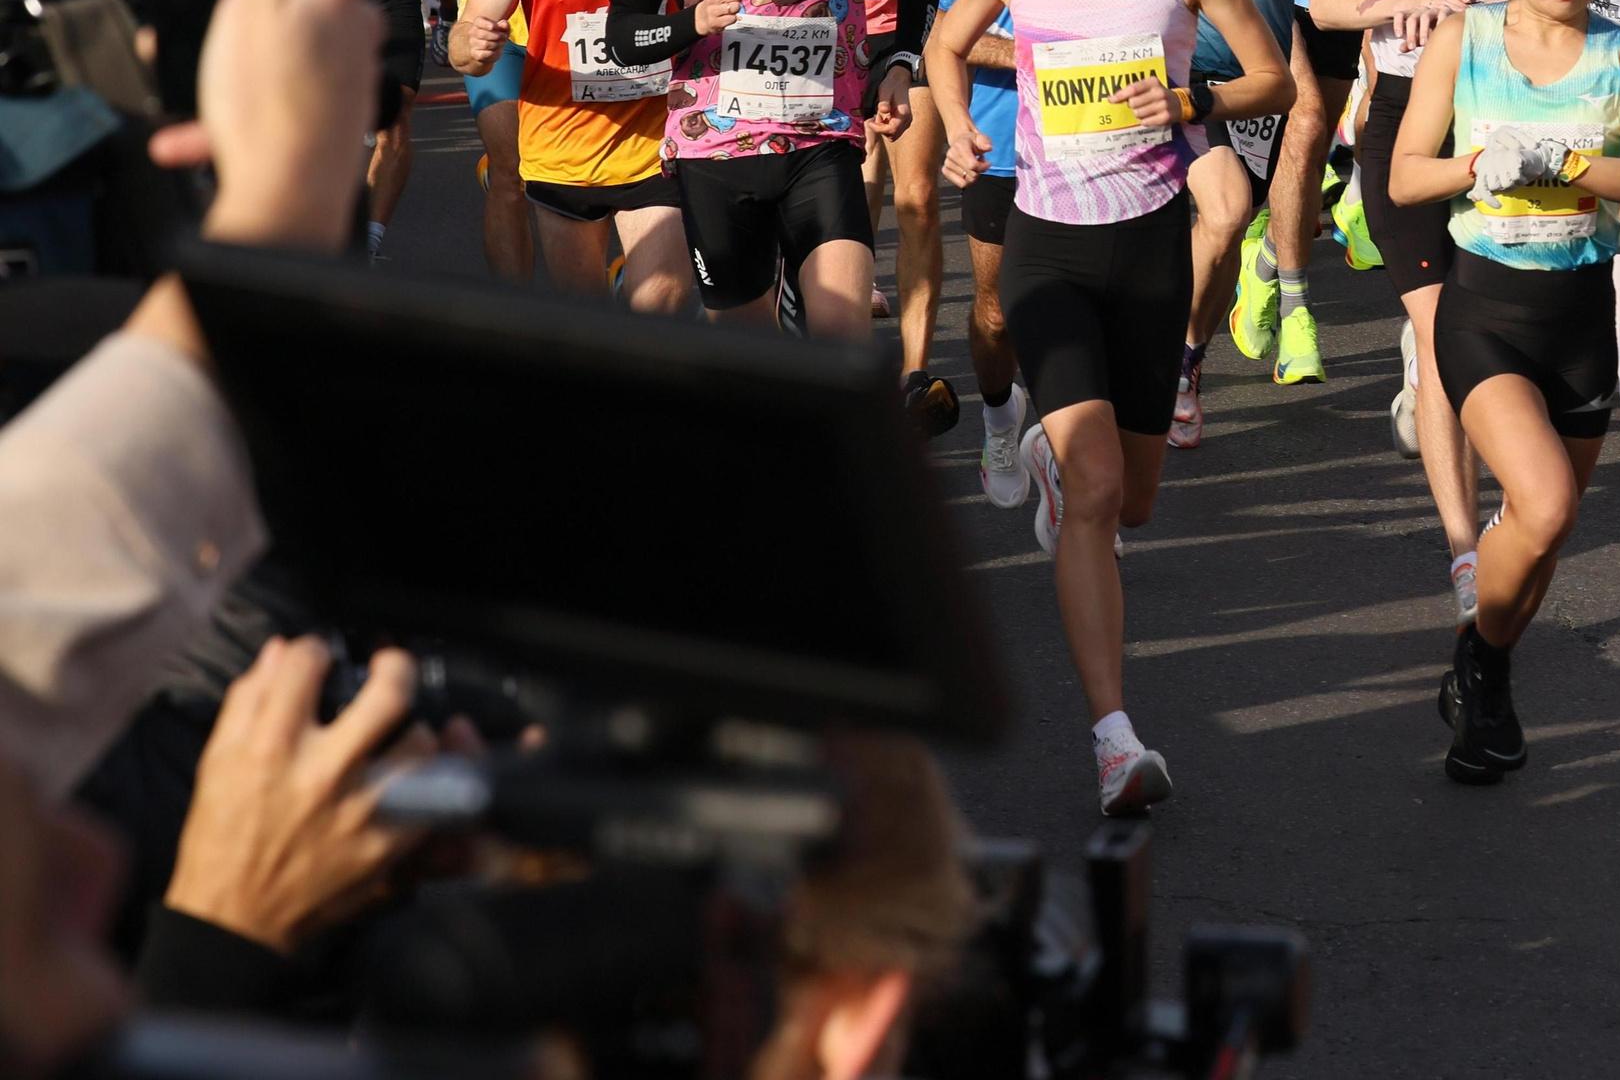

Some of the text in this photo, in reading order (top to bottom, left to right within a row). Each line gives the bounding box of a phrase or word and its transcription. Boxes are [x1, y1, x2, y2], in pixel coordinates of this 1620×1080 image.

[782, 30, 808, 40] 42,2
[727, 40, 833, 76] 14537
[1099, 51, 1128, 64] 42,2
[596, 64, 650, 76] АЛЕКСАНДР
[765, 81, 790, 91] ОЛЕГ
[1099, 115, 1112, 125] 35
